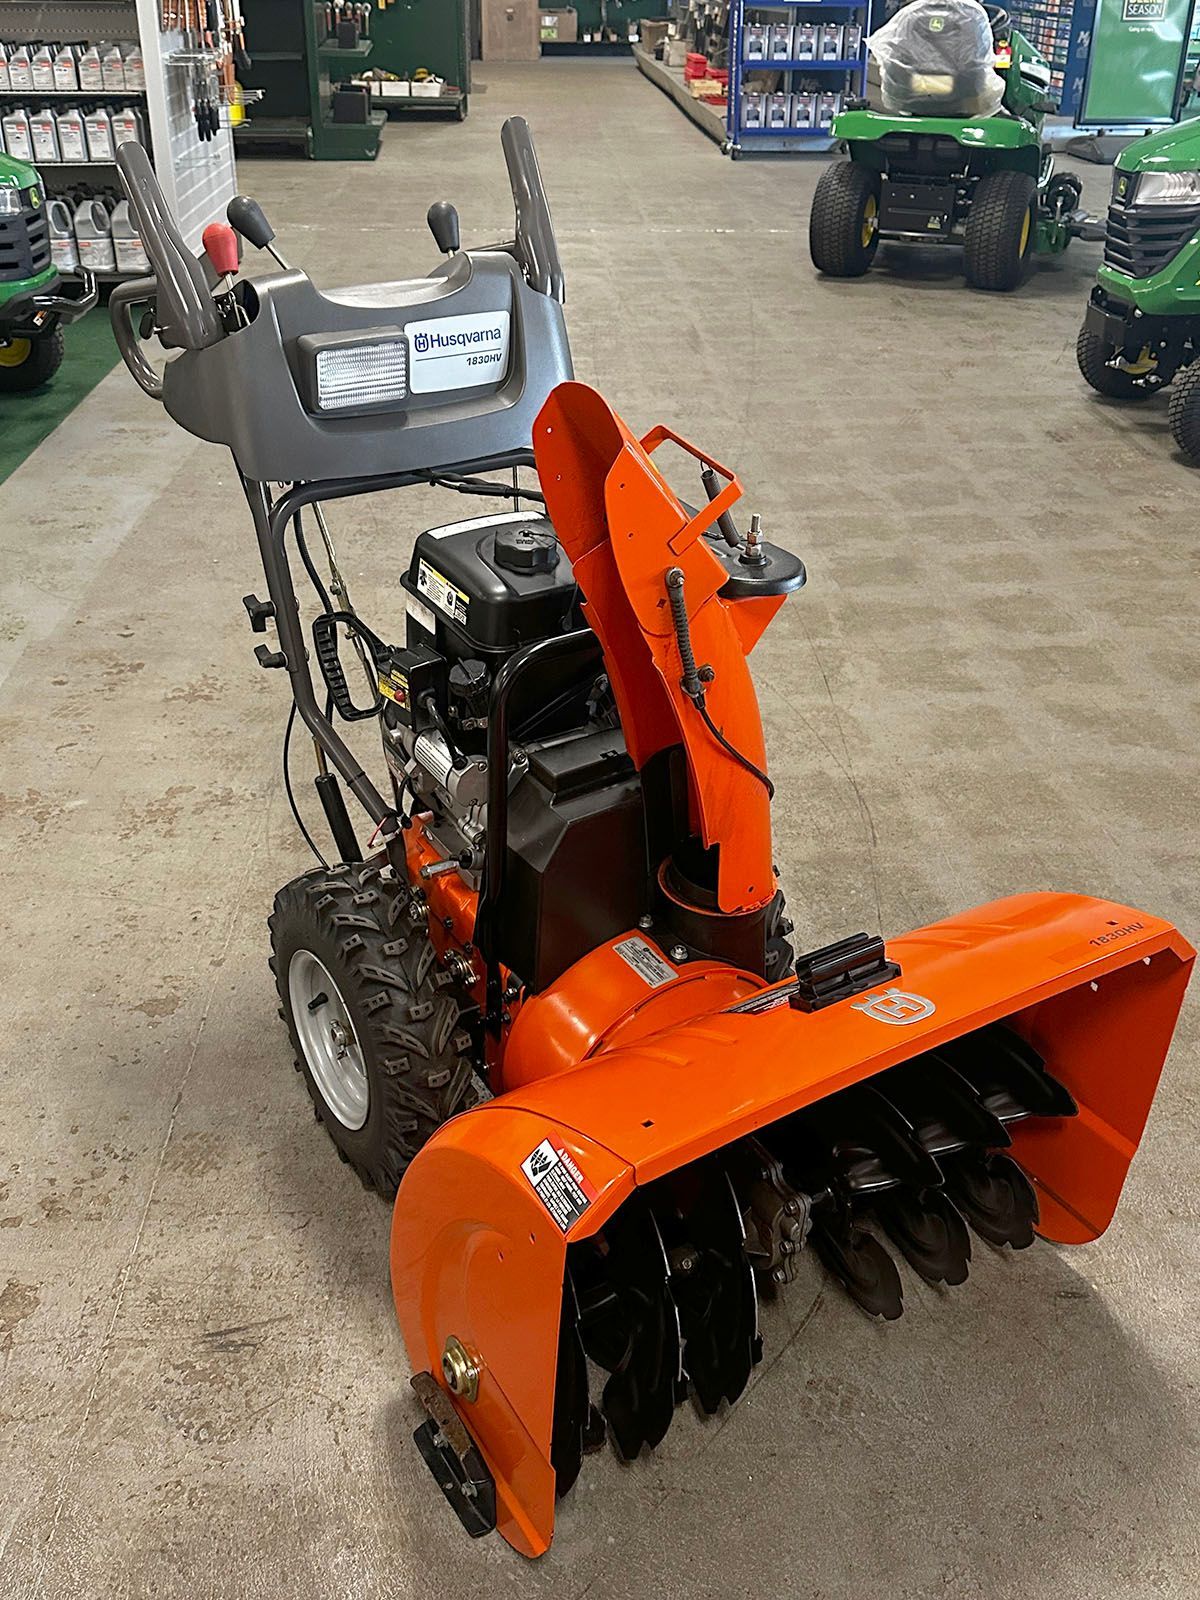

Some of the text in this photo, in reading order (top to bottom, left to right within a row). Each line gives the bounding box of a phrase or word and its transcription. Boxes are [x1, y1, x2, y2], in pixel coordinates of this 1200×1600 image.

[1127, 4, 1162, 15] SEASON
[430, 328, 501, 348] Husqvarna
[466, 353, 502, 366] 1830HV
[1089, 922, 1144, 947] 1830HV
[561, 1153, 584, 1184] DANGER
